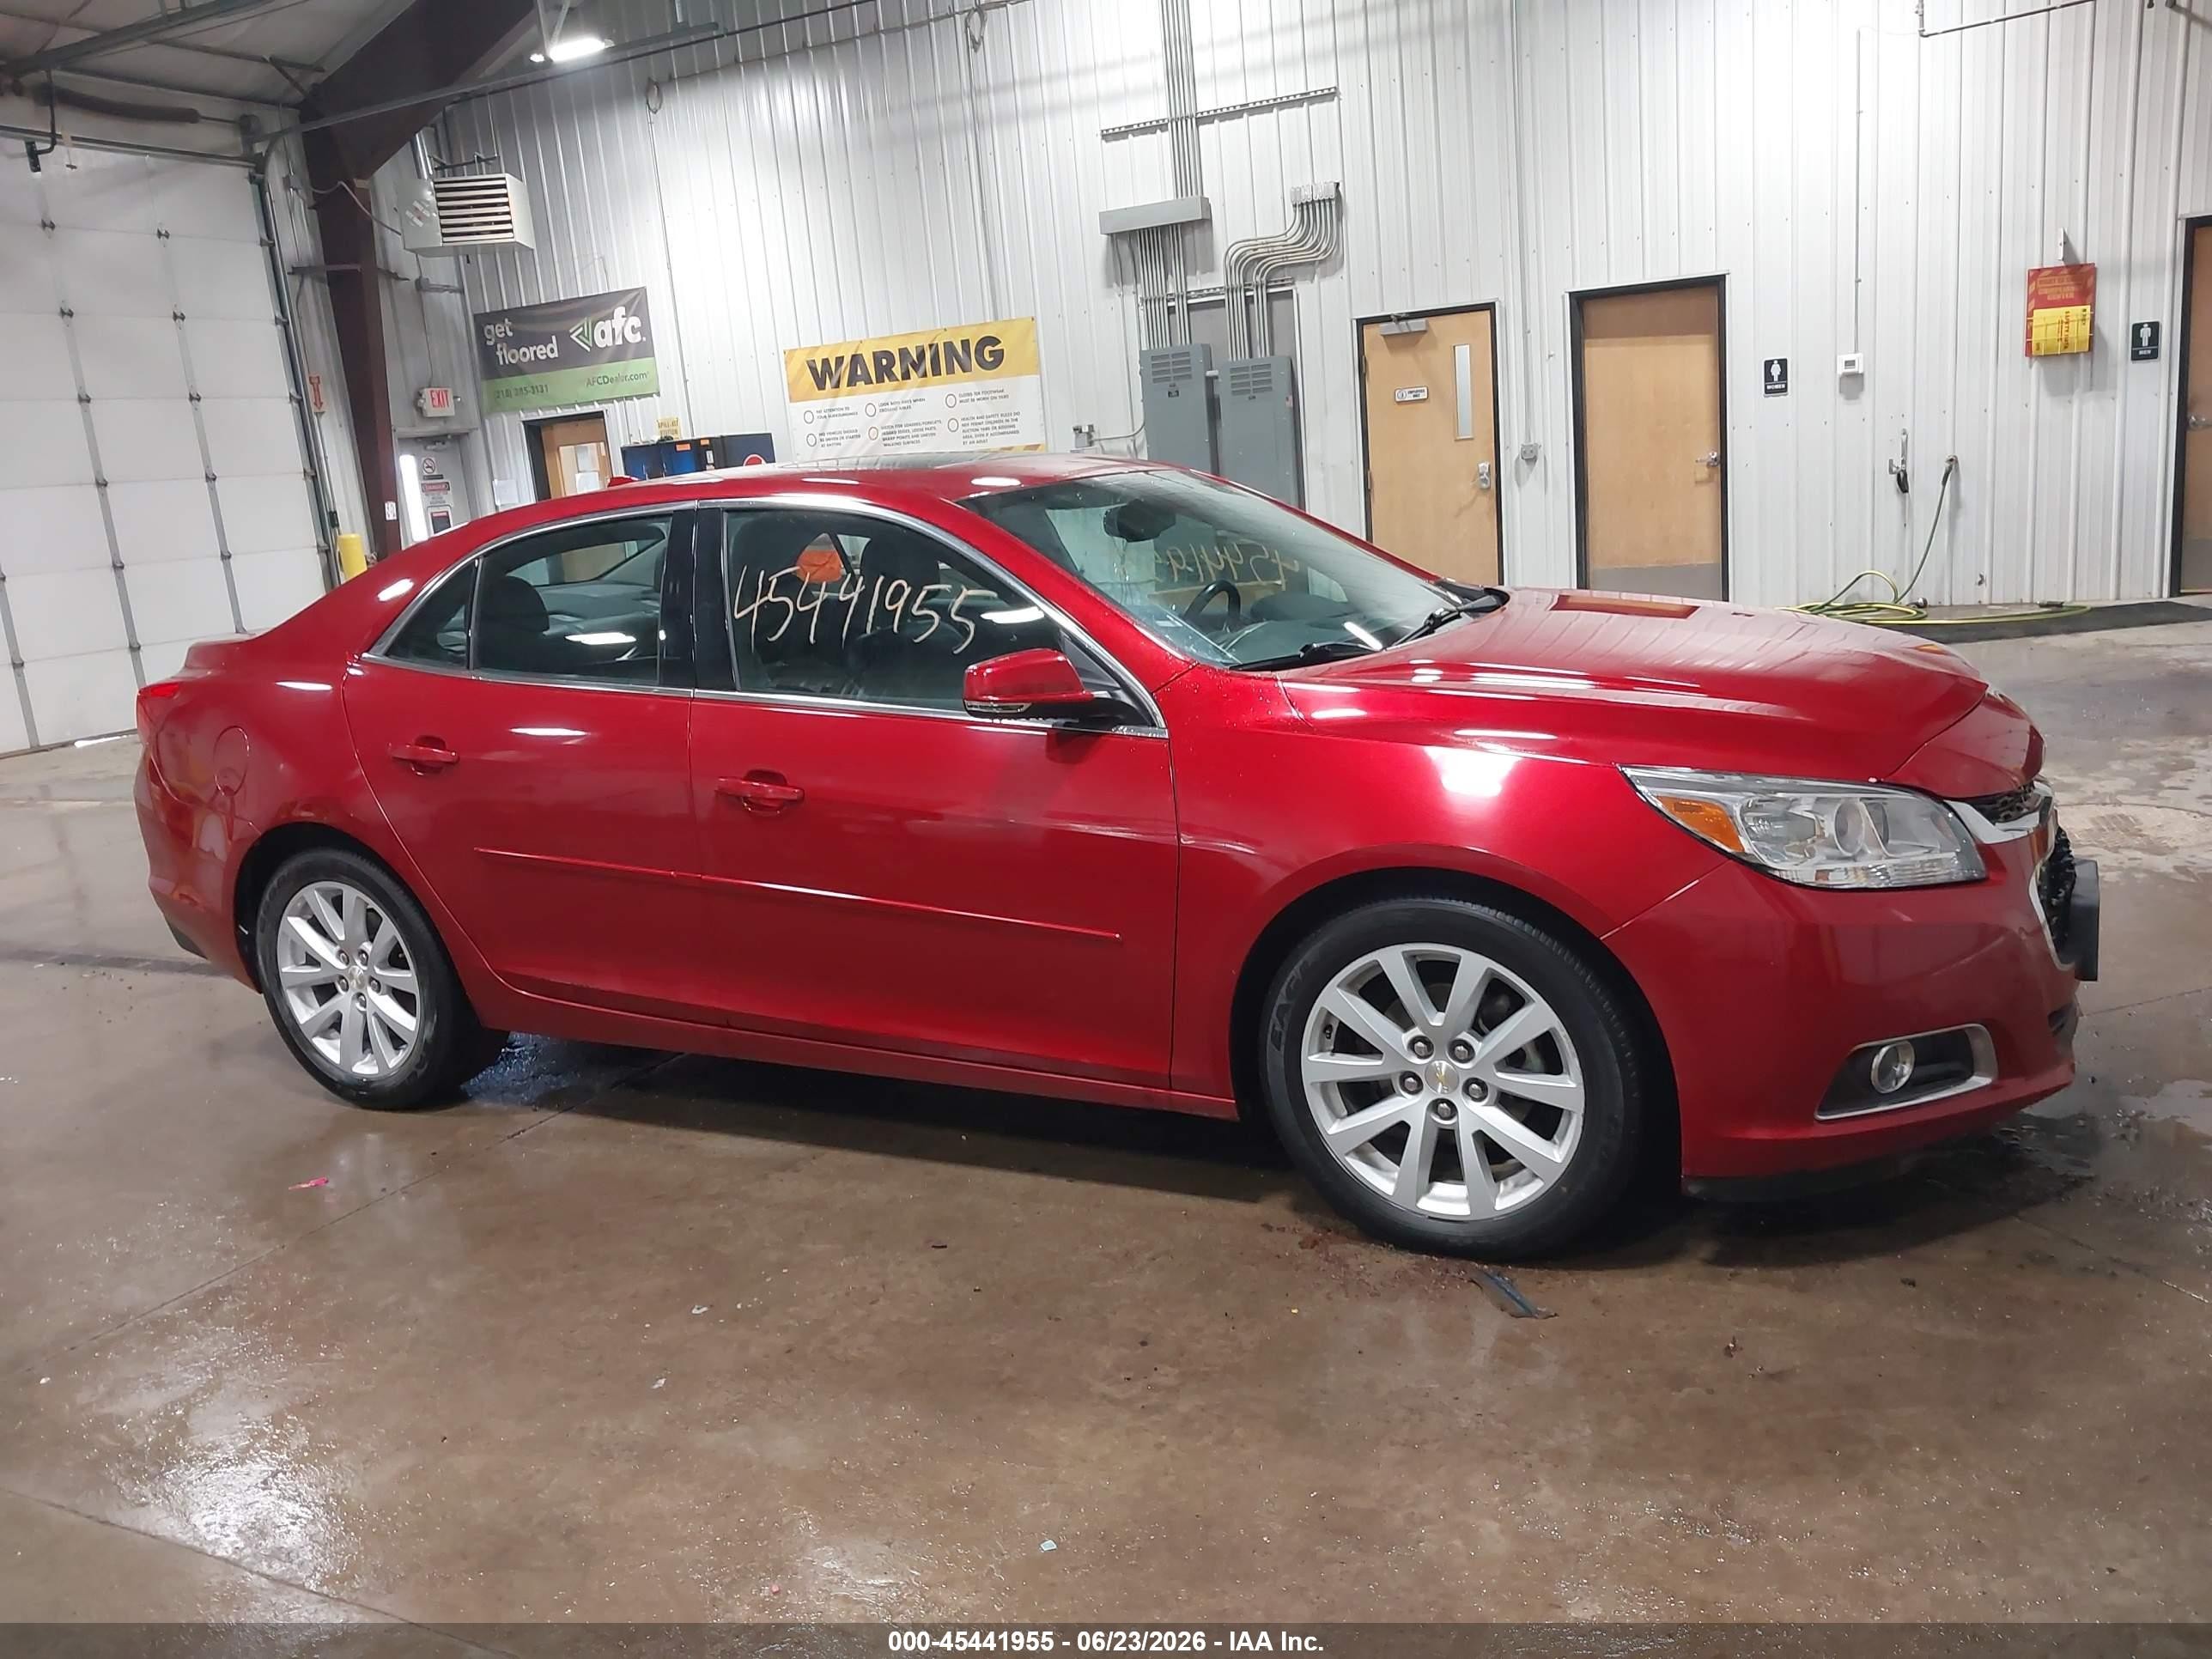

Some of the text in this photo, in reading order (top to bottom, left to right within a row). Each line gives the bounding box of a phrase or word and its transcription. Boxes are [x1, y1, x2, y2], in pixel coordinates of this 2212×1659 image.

[483, 318, 514, 346] get
[495, 335, 558, 366] floored
[805, 335, 1005, 392] WARNING
[429, 390, 450, 409] EXIT
[733, 563, 999, 655] 45441955
